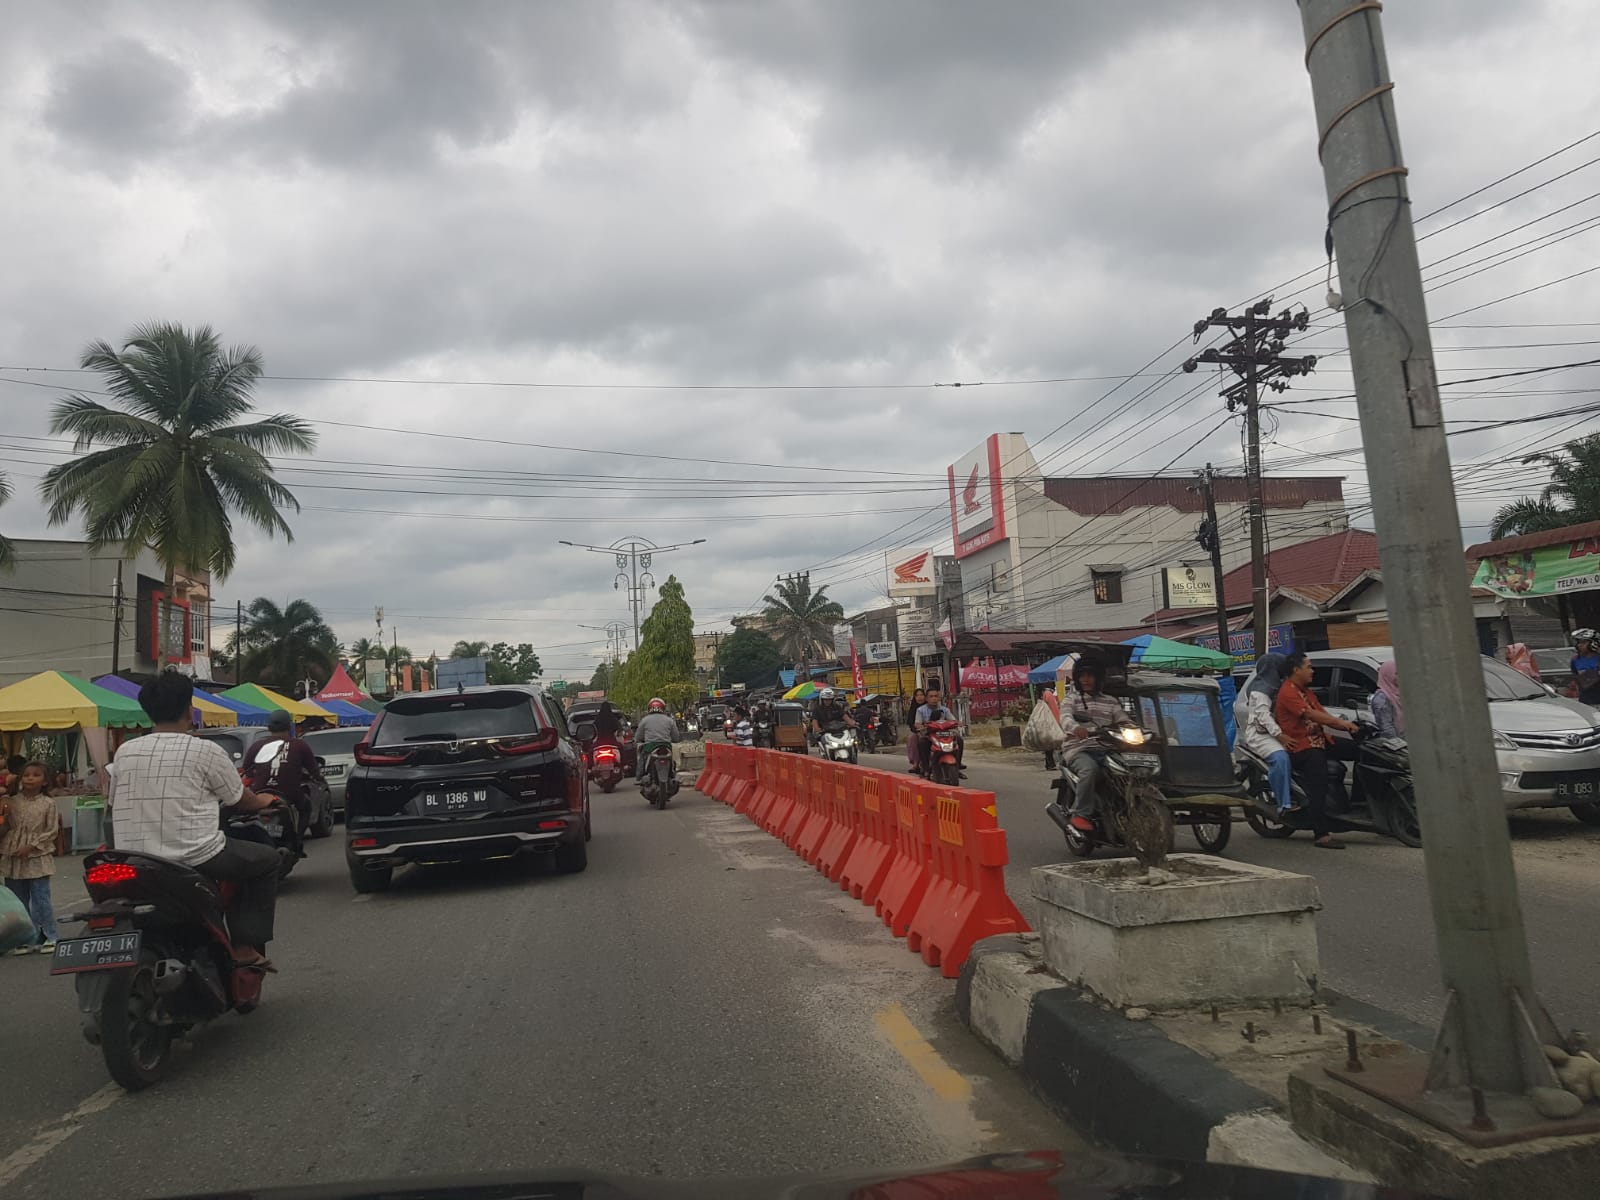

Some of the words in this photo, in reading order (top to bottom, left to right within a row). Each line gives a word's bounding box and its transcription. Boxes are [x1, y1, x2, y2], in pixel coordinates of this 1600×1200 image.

[895, 576, 930, 584] HONDA
[1559, 783, 1568, 795] BL
[426, 795, 438, 806] BL
[446, 791, 469, 804] 1386
[474, 790, 486, 802] WU
[59, 944, 73, 957] BL
[81, 940, 112, 954] 6709
[120, 937, 135, 950] IK
